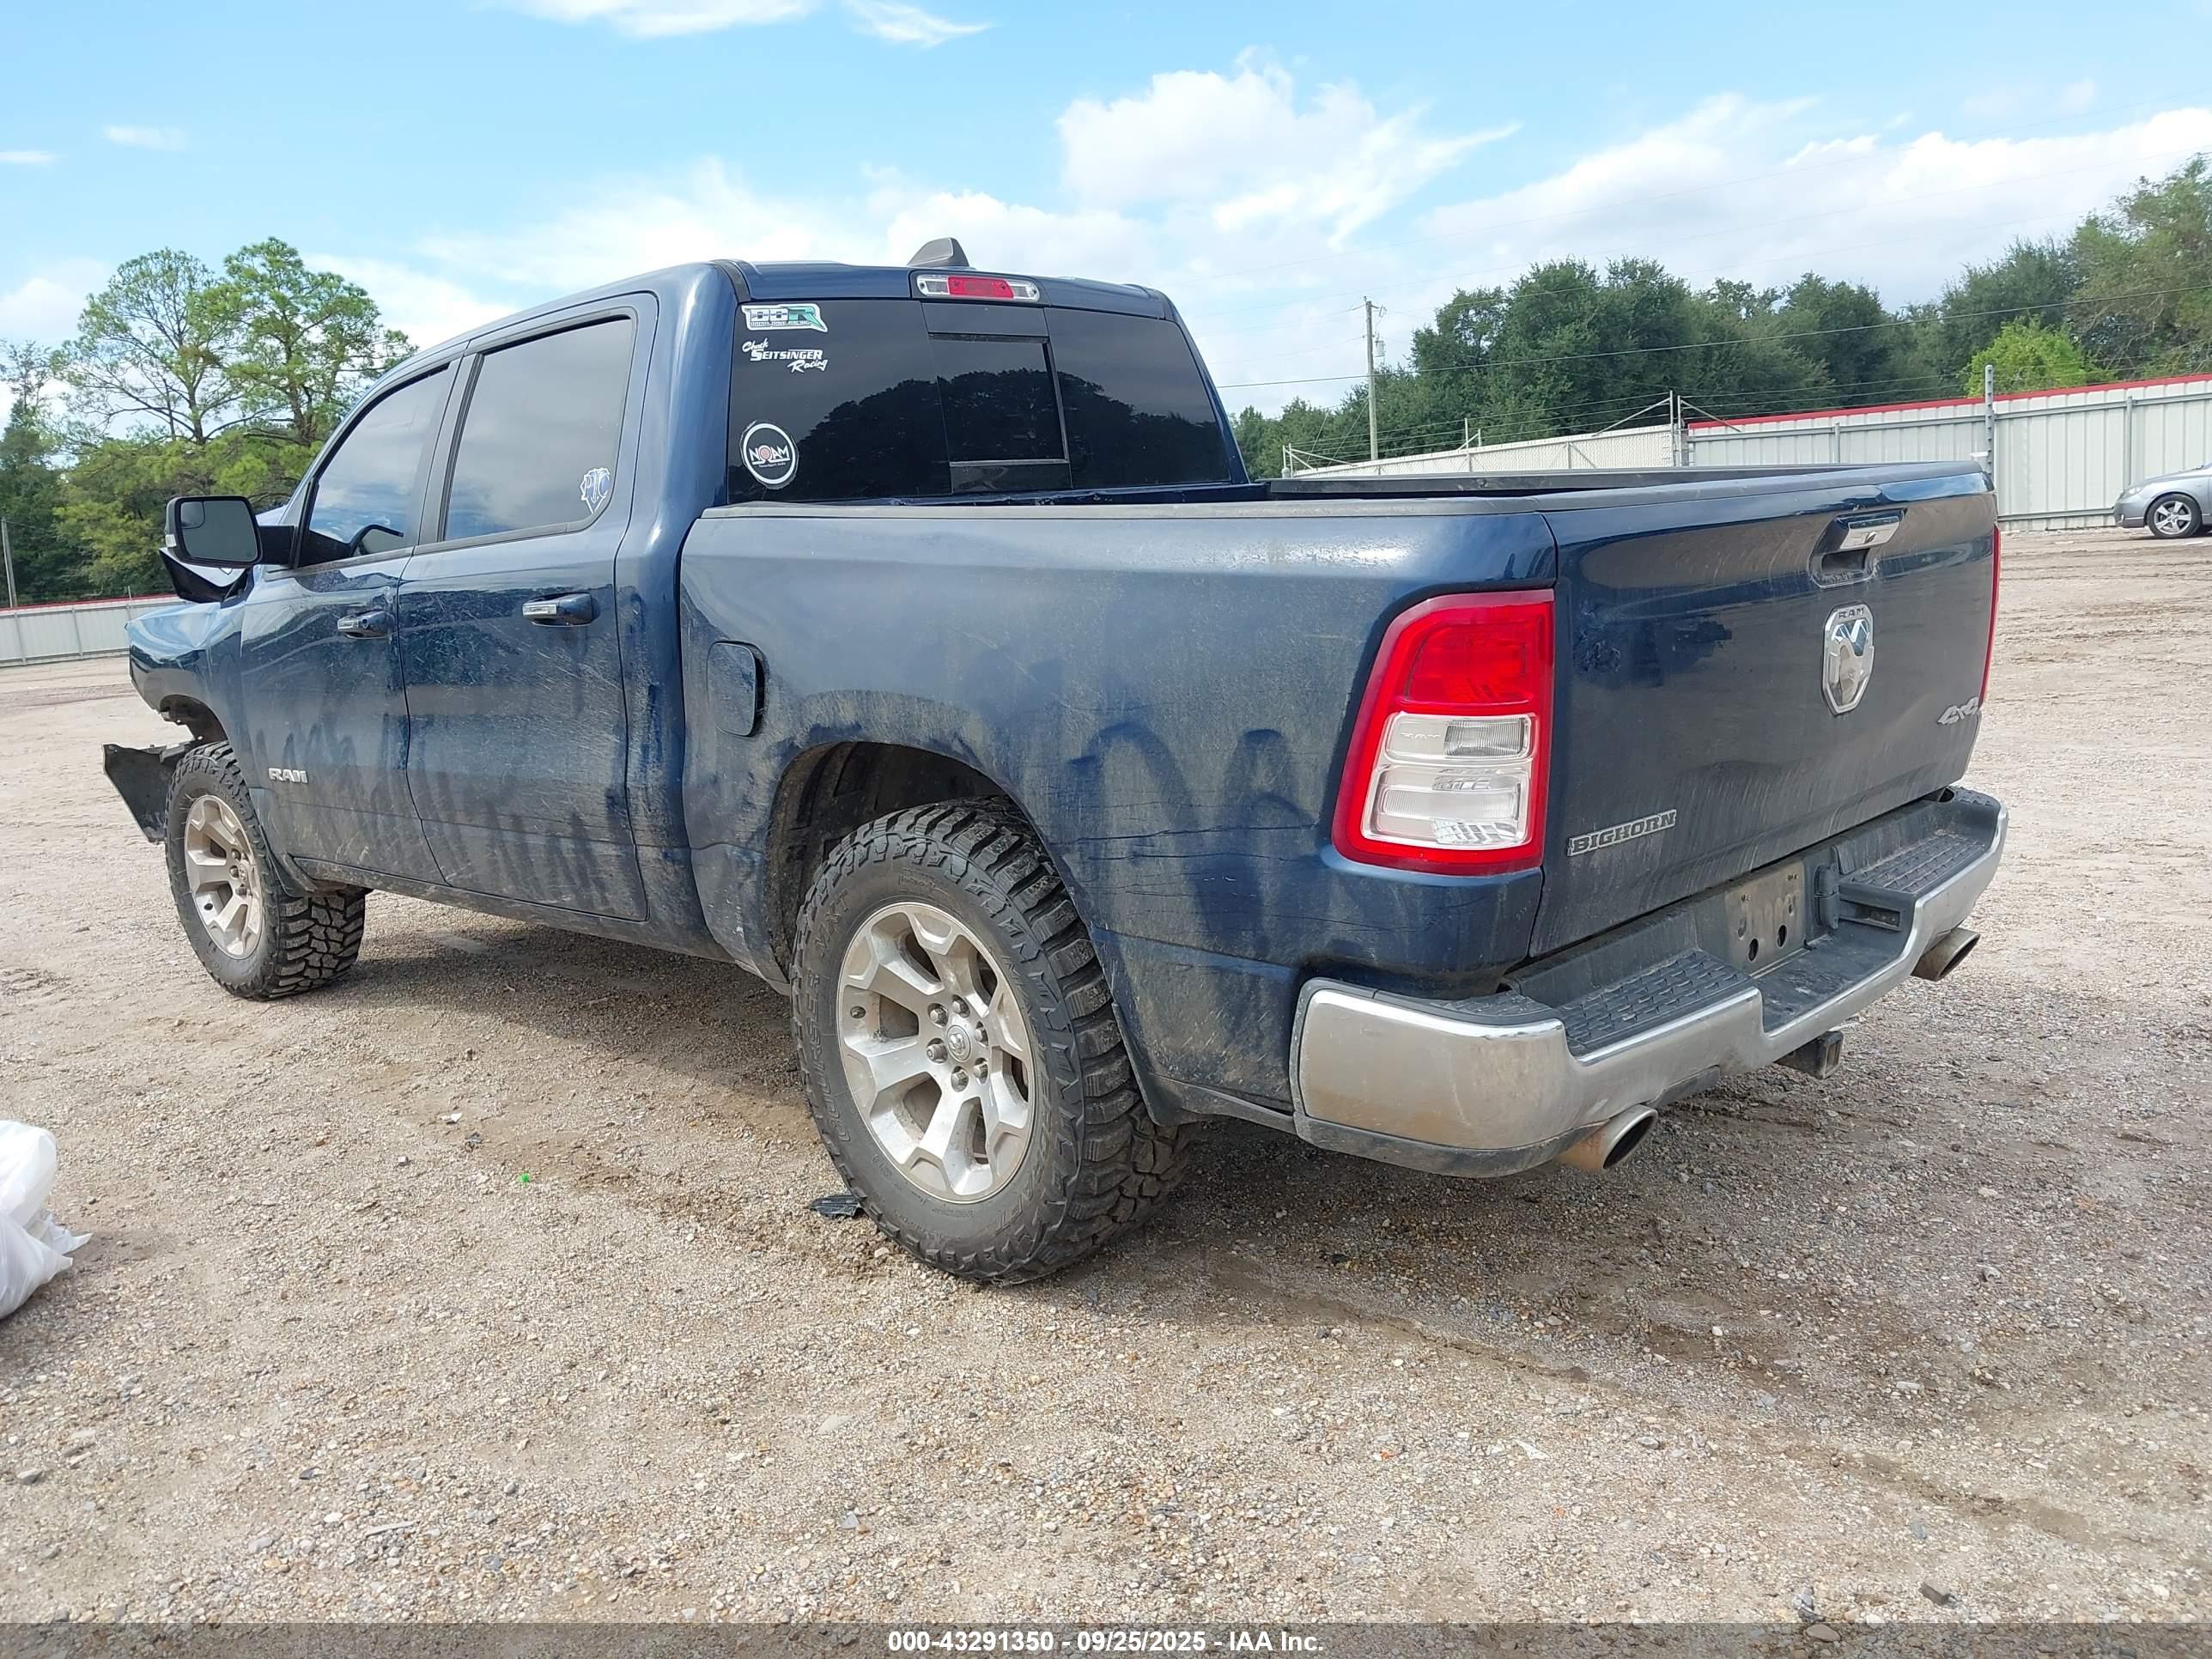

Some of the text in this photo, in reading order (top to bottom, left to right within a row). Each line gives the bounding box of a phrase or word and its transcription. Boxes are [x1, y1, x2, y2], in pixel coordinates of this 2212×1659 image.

[742, 337, 769, 353] Chuck
[750, 349, 823, 362] SEITSINGER
[787, 359, 829, 373] Racing
[1838, 607, 1864, 619] RAM
[268, 768, 308, 783] RAM
[1567, 809, 1676, 856] BIGHORN
